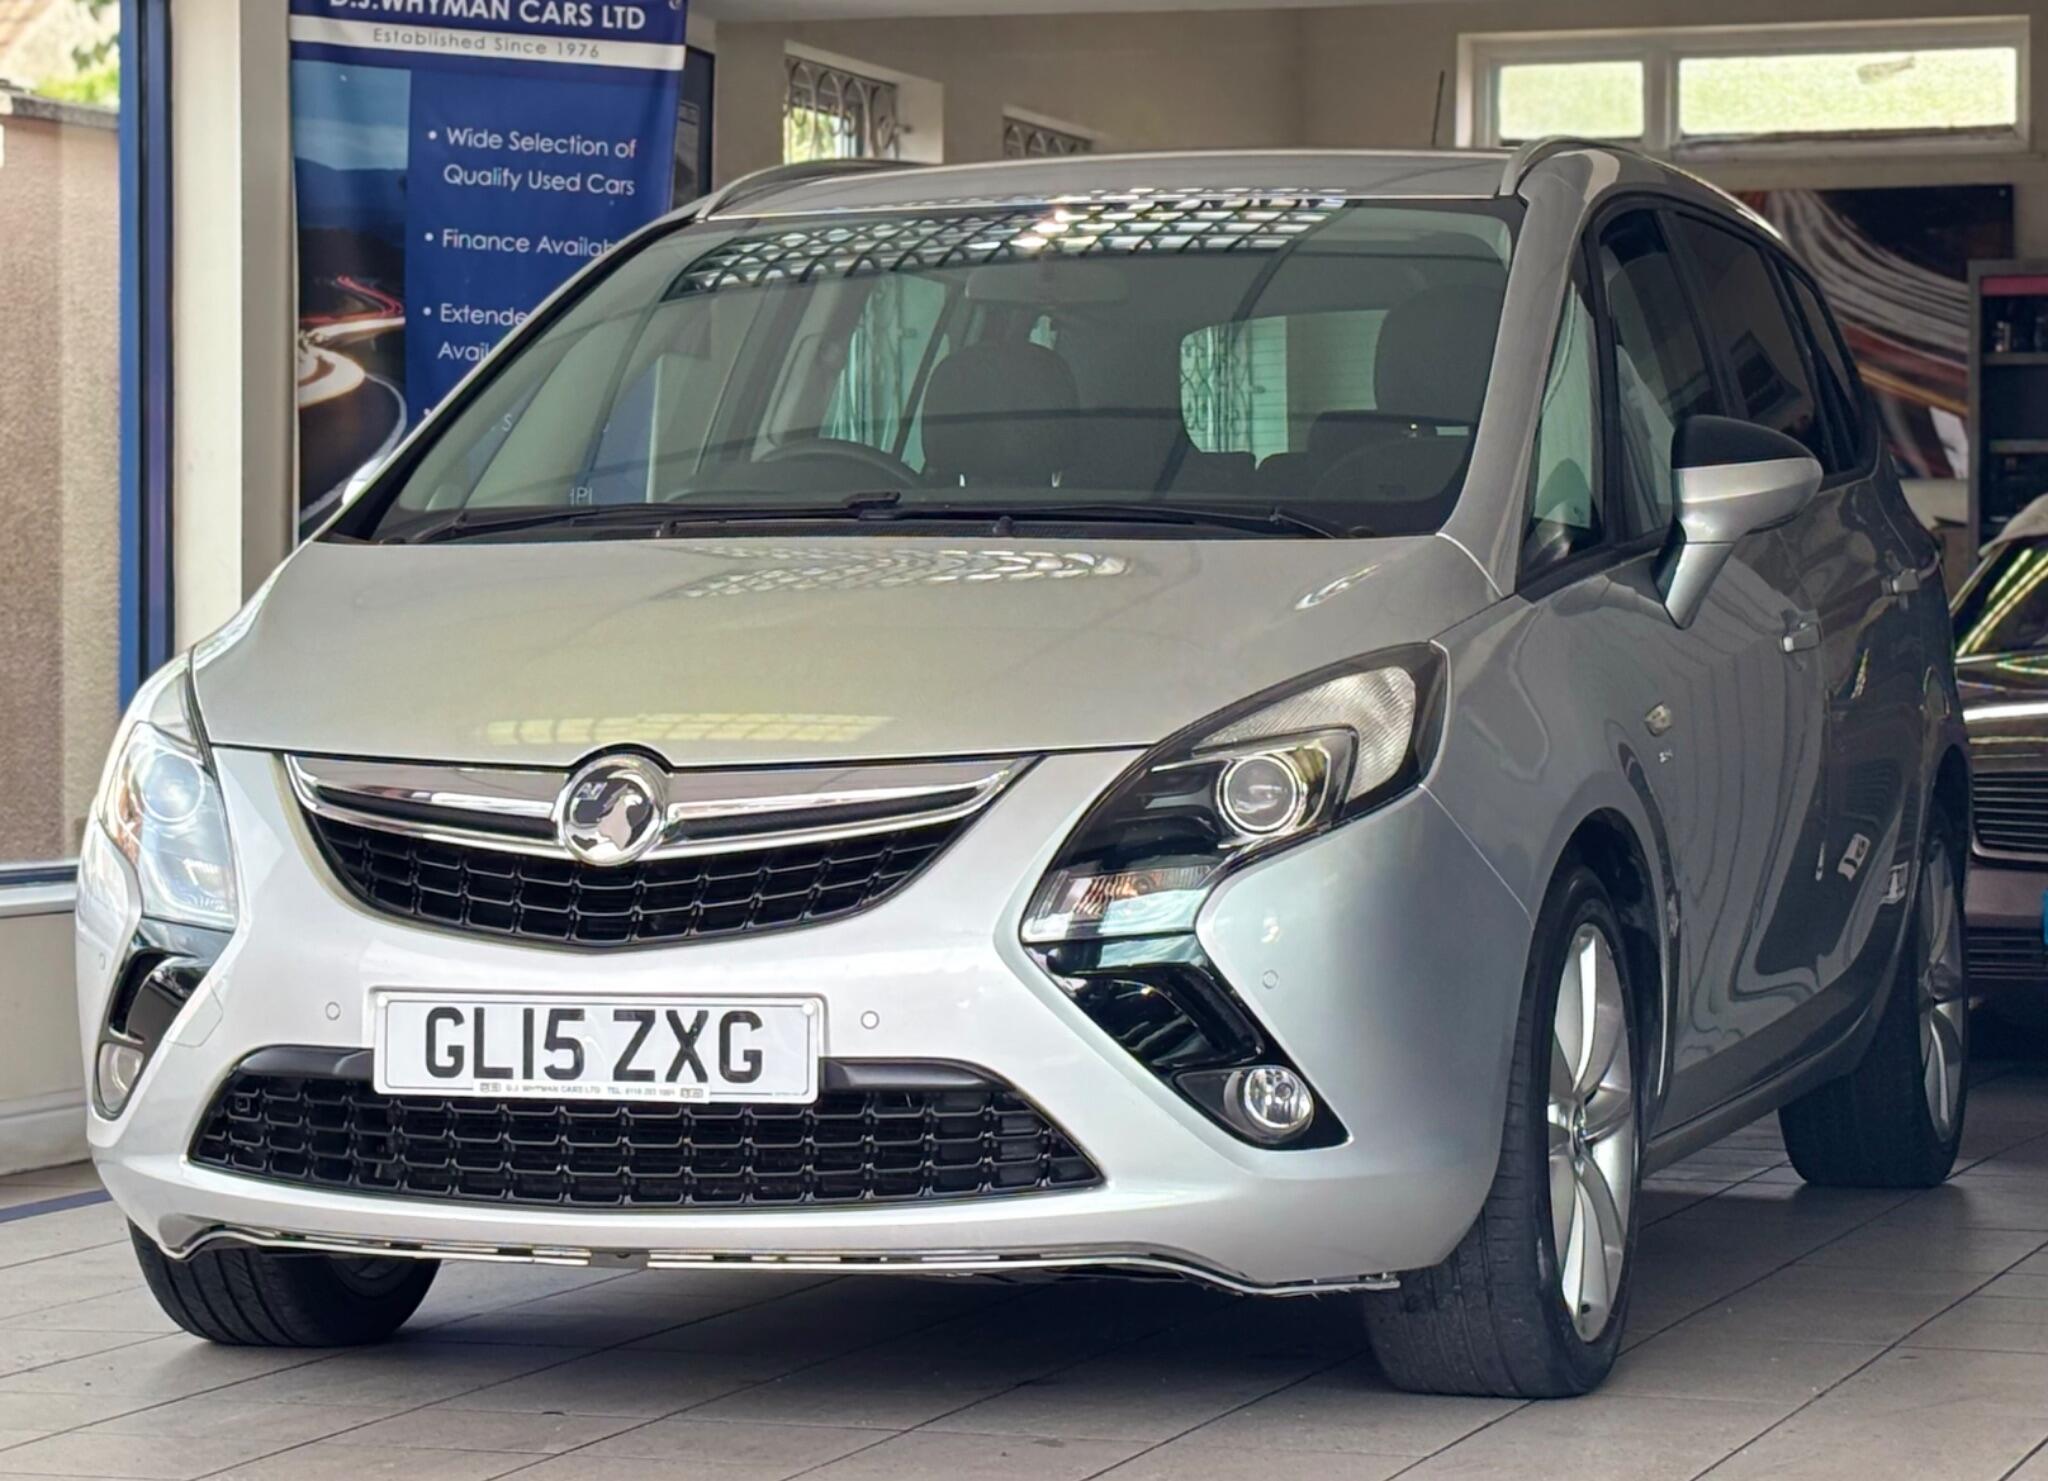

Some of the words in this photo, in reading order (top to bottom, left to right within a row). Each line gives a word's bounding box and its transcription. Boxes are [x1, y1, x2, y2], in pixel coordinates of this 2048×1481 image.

[330, 0, 510, 20] ..WHYMAN
[519, 0, 593, 27] CARS
[601, 5, 646, 30] LTD
[373, 28, 486, 50] Established
[494, 37, 547, 55] Since
[557, 42, 599, 58] 1976
[446, 127, 503, 149] Wide
[508, 130, 609, 156] Selection
[614, 139, 637, 158] of
[528, 170, 581, 191] Used
[587, 173, 635, 195] Cars
[442, 229, 530, 252] Finance
[536, 236, 615, 257] Availab
[441, 303, 529, 326] Extende
[438, 341, 490, 361] Avail
[425, 1007, 586, 1080] GL15
[613, 1010, 763, 1084] ZXG
